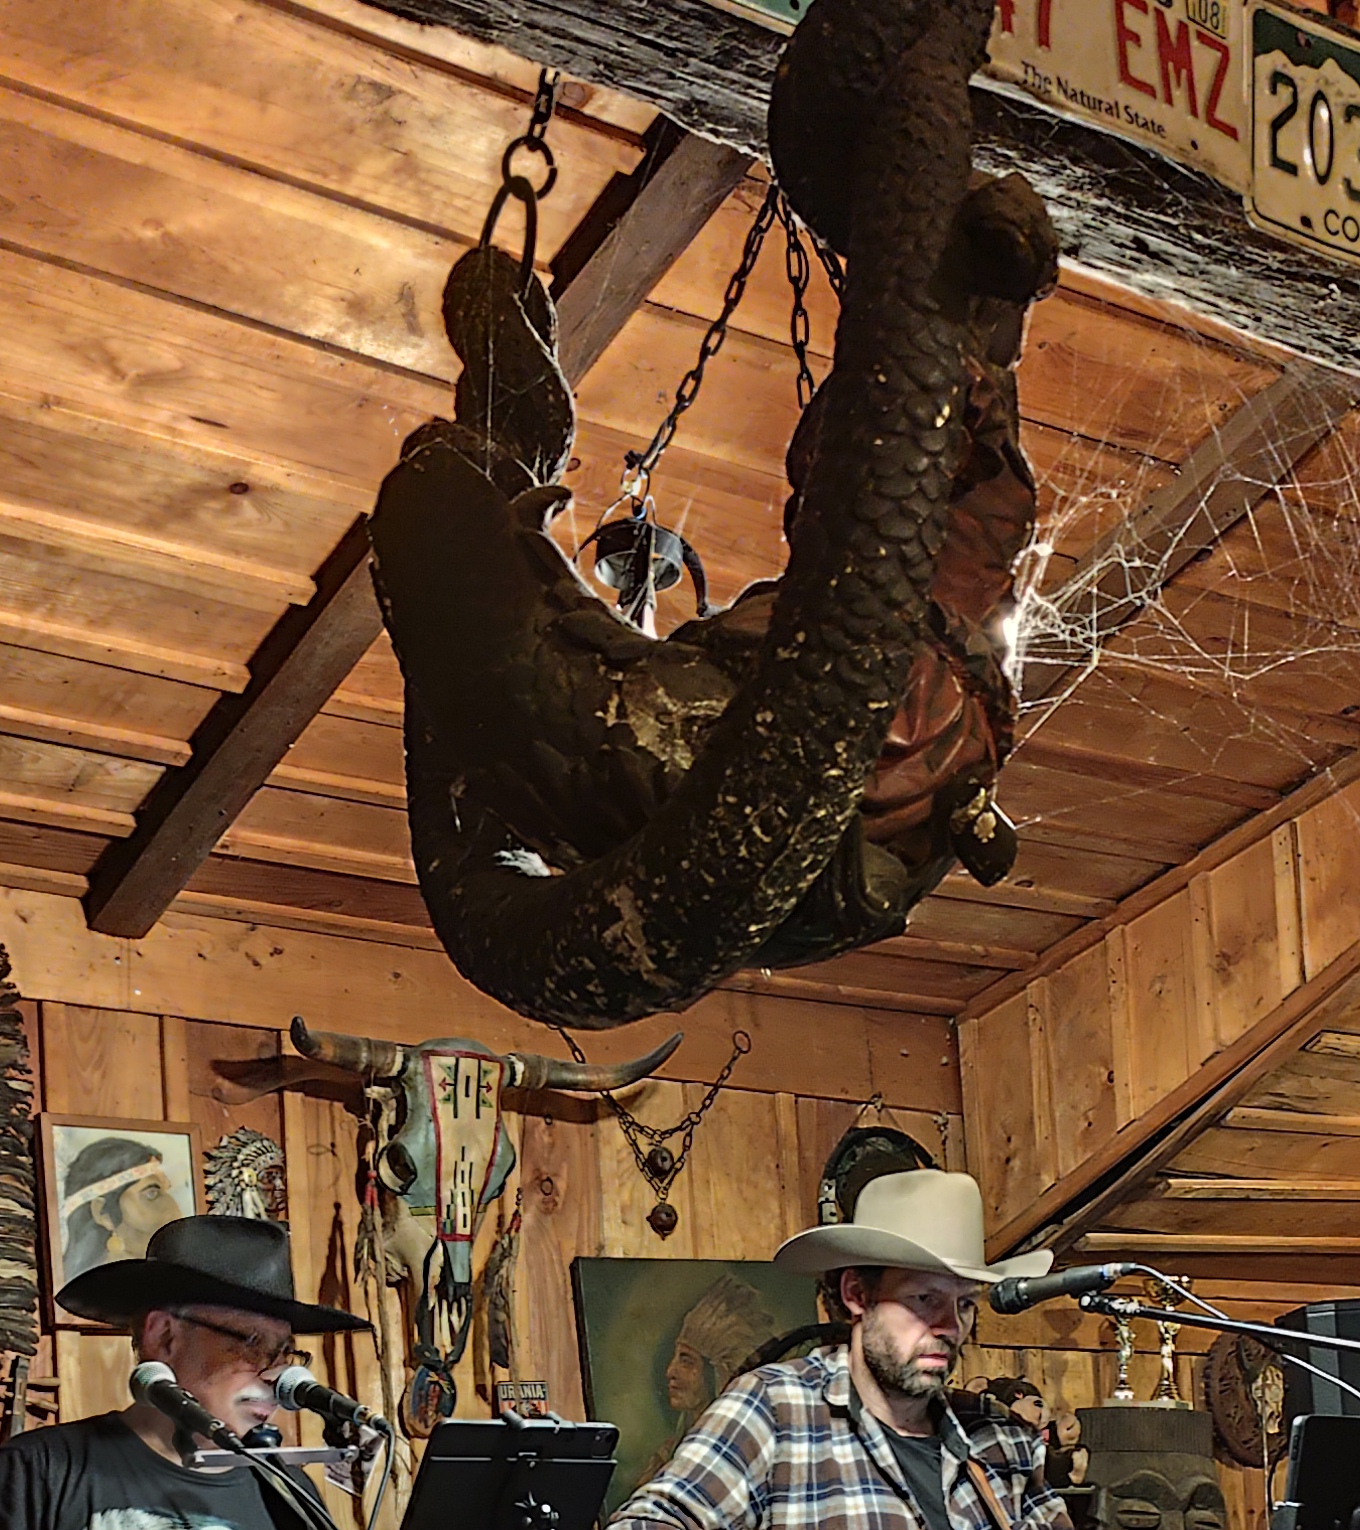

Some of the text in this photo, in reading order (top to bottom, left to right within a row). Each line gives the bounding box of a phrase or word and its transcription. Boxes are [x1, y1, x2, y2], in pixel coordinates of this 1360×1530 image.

[1021, 61, 1167, 138] The Natural State
[1114, 0, 1239, 142] EMZ
